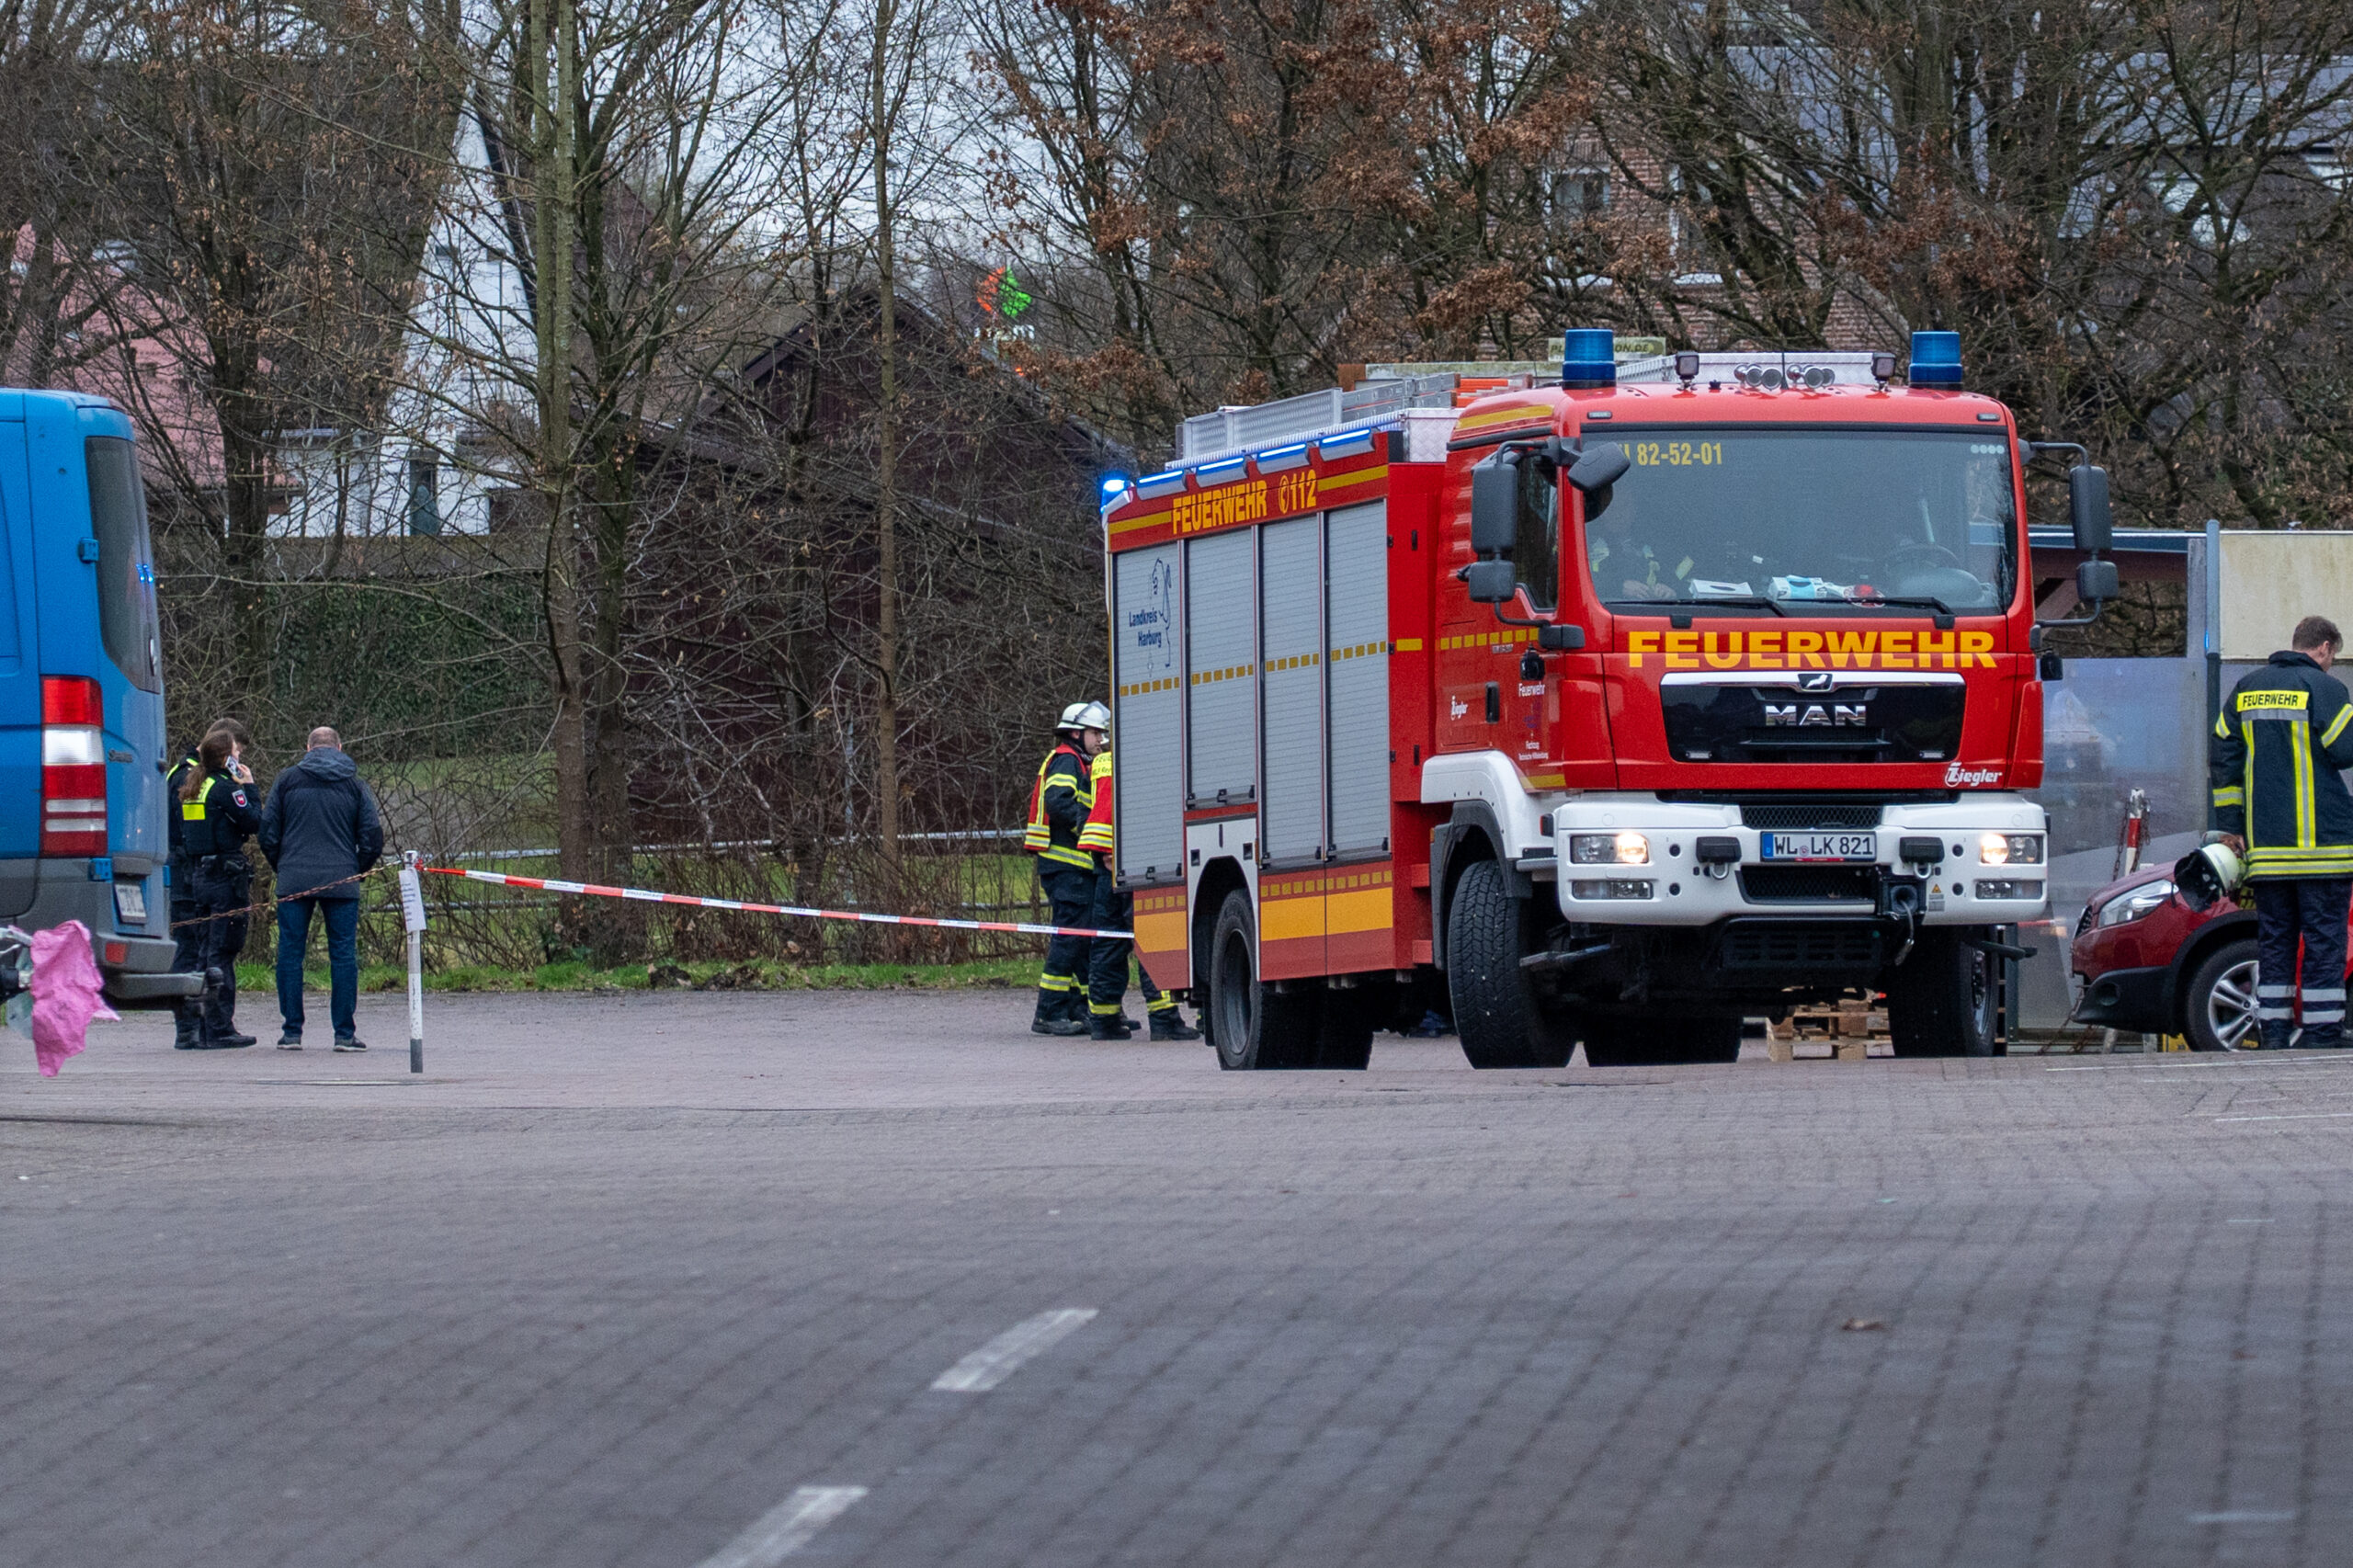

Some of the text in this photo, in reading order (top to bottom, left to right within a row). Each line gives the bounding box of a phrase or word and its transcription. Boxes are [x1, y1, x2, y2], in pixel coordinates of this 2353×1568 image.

[1637, 442, 1722, 466] 82-52-01
[1173, 469, 1317, 535] FEUERWEHR 112
[1129, 608, 1157, 627] Landkreis
[1138, 630, 1161, 648] Harburg
[1629, 631, 1997, 668] FEUERWEHR
[2243, 693, 2299, 707] FEUERWEHR
[1766, 705, 1866, 726] MAN
[1945, 762, 2003, 788] Ziegler
[1774, 836, 1798, 855] WL
[1811, 836, 1835, 855] LK
[1839, 836, 1873, 855] 821
